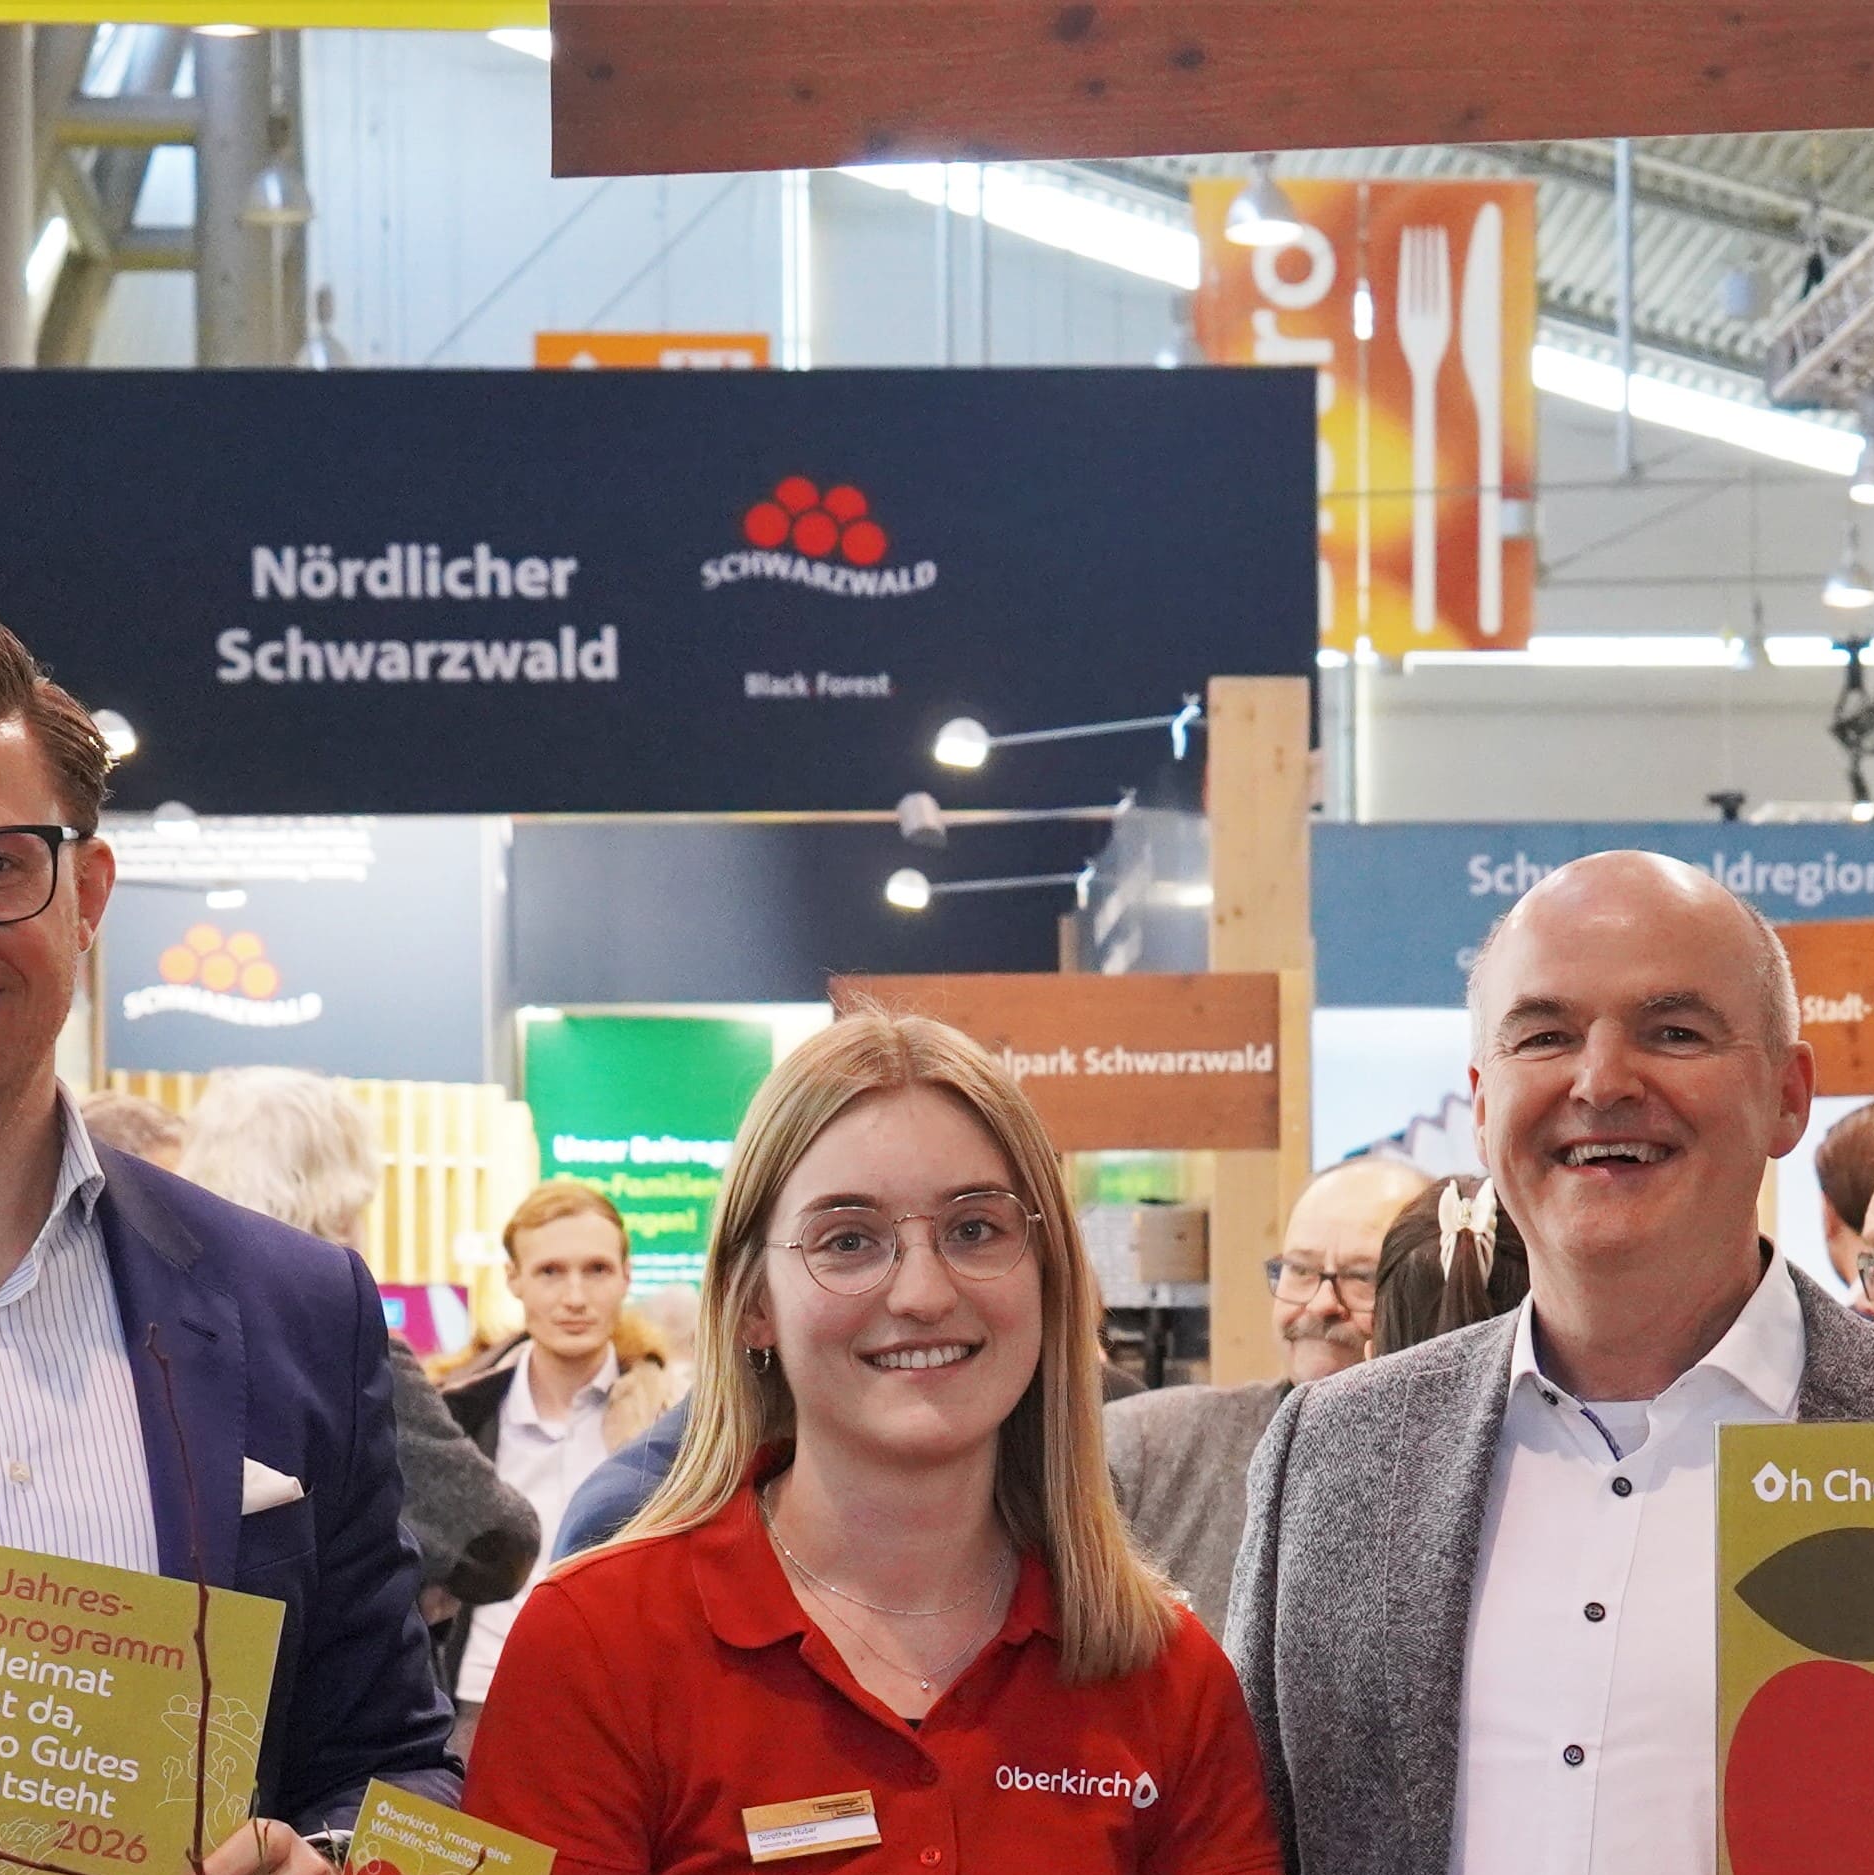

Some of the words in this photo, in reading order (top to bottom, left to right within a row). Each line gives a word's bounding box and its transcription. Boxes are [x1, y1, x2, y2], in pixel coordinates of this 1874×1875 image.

[252, 543, 578, 599] Nördlicher
[702, 551, 937, 598] SCHWARZWALD
[217, 625, 619, 682] Schwarzwald
[744, 672, 809, 698] Black
[816, 672, 892, 698] Forest
[1803, 991, 1872, 1023] Stadt-
[1084, 1043, 1274, 1076] Schwarzwald
[1751, 1461, 1813, 1502] Oh
[27, 1693, 83, 1738] da,
[31, 1735, 140, 1785] Gutes
[996, 1764, 1132, 1799] Oberkirch
[377, 1800, 442, 1840] Oberkirch,
[52, 1819, 149, 1865] 2026
